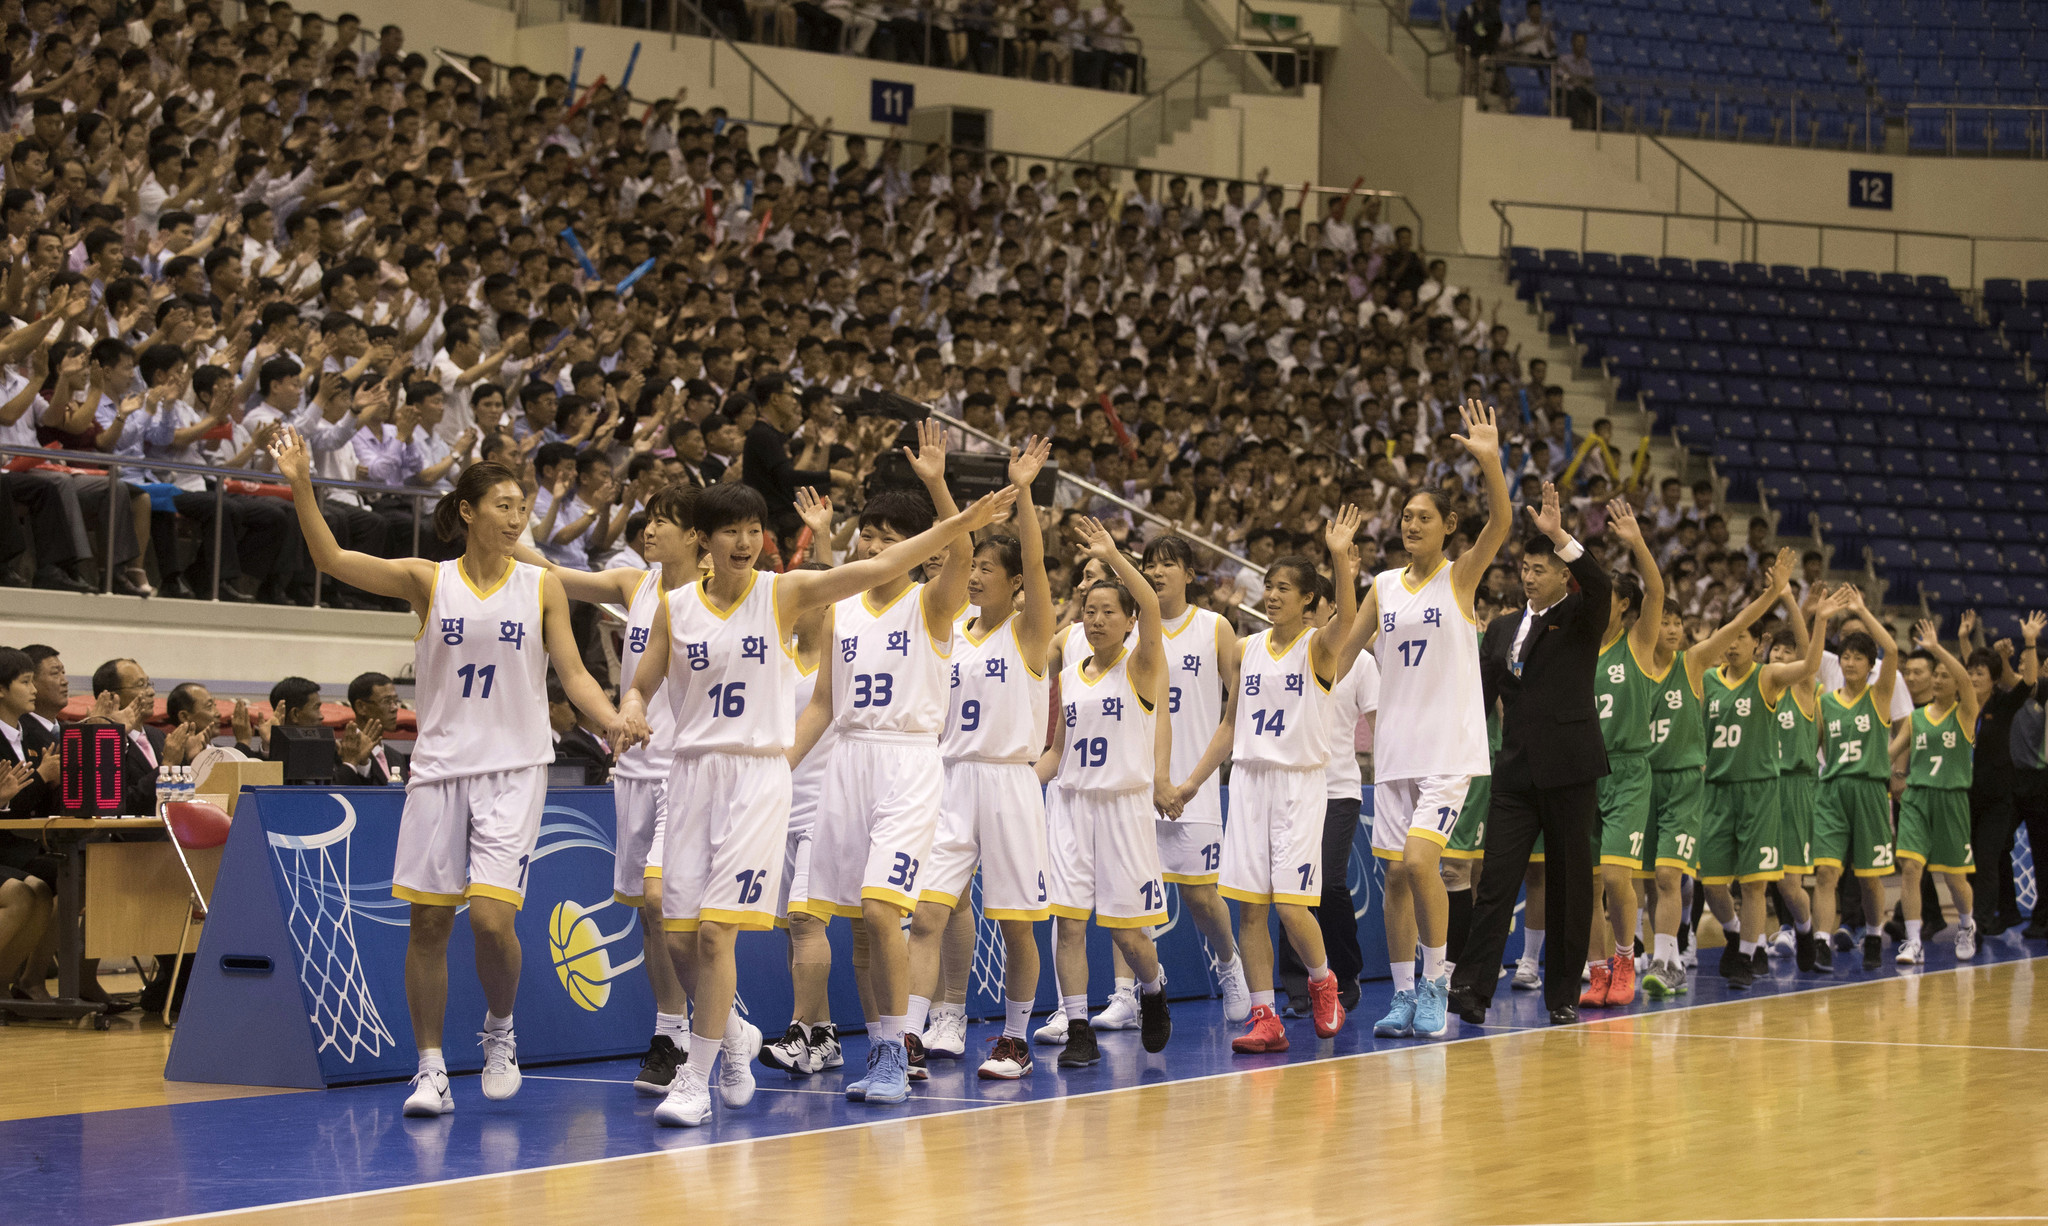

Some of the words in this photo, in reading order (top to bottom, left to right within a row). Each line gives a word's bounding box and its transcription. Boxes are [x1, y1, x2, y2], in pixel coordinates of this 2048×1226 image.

[882, 88, 903, 117] 11
[1859, 177, 1884, 202] 12
[1383, 611, 1396, 632] 평
[1423, 607, 1442, 626] 화
[441, 617, 465, 645] 평
[498, 620, 526, 650] 화
[629, 626, 649, 653] 평
[841, 635, 859, 662] 평
[886, 630, 911, 656] 화
[687, 641, 709, 671] 평
[741, 635, 768, 664] 화
[1182, 654, 1201, 676] 화
[1398, 639, 1428, 666] 17
[457, 663, 496, 698] 11
[985, 657, 1008, 682] 화
[1606, 662, 1626, 683] 영
[853, 672, 894, 708] 33
[1245, 673, 1261, 695] 평
[1285, 673, 1304, 696] 화
[708, 681, 746, 717] 16
[1101, 696, 1124, 720] 화
[1170, 686, 1182, 713] 3
[1595, 693, 1614, 719] 2
[1664, 688, 1683, 709] 영
[1734, 697, 1752, 716] 영
[960, 699, 981, 731] 9
[1251, 708, 1286, 736] 14
[1777, 709, 1796, 729] 영
[1828, 718, 1842, 738] 번
[1853, 713, 1871, 732] 영
[1712, 723, 1742, 748] 20
[1915, 731, 1928, 750] 번
[1941, 730, 1957, 748] 영
[1073, 736, 1108, 767] 19
[1838, 740, 1862, 764] 25
[1929, 755, 1943, 776] 7
[1200, 842, 1221, 870] 13
[1675, 833, 1696, 860] 15
[1872, 843, 1892, 867] 25
[887, 851, 919, 892] 33
[735, 869, 767, 903] 16
[1037, 870, 1047, 902] 9
[1140, 879, 1163, 910] 19
